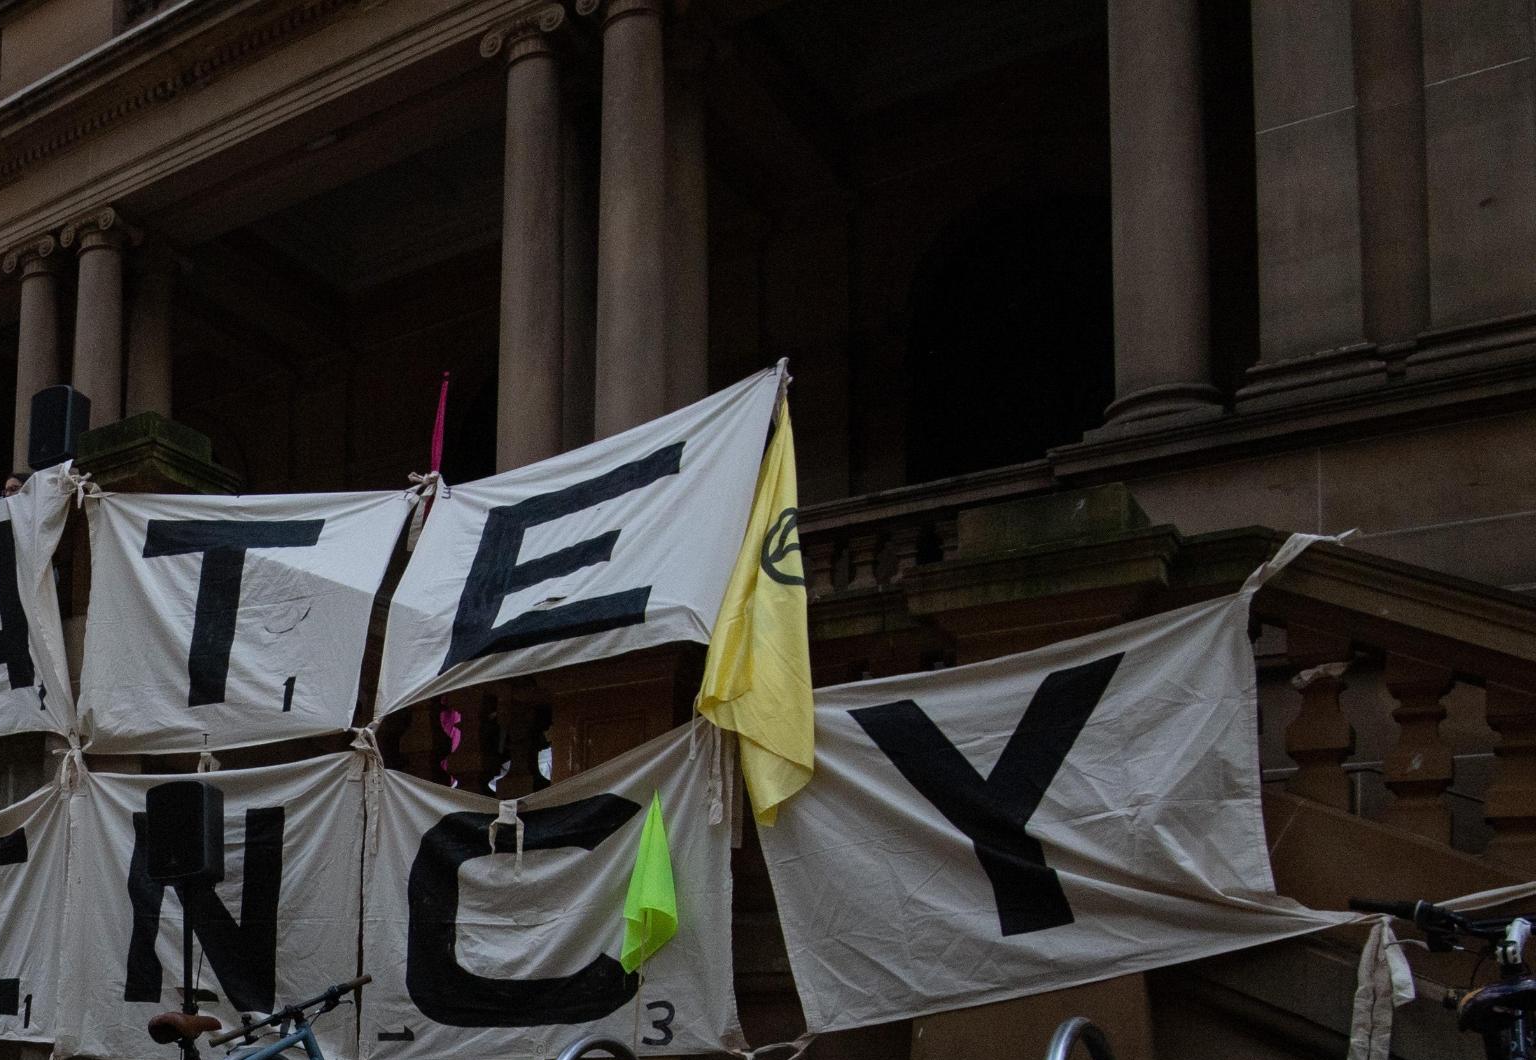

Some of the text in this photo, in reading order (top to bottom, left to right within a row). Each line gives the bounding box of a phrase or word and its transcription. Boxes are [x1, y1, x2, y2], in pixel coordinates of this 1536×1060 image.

[282, 676, 296, 712] 1
[24, 994, 32, 1028] 1
[642, 1001, 675, 1046] 3
